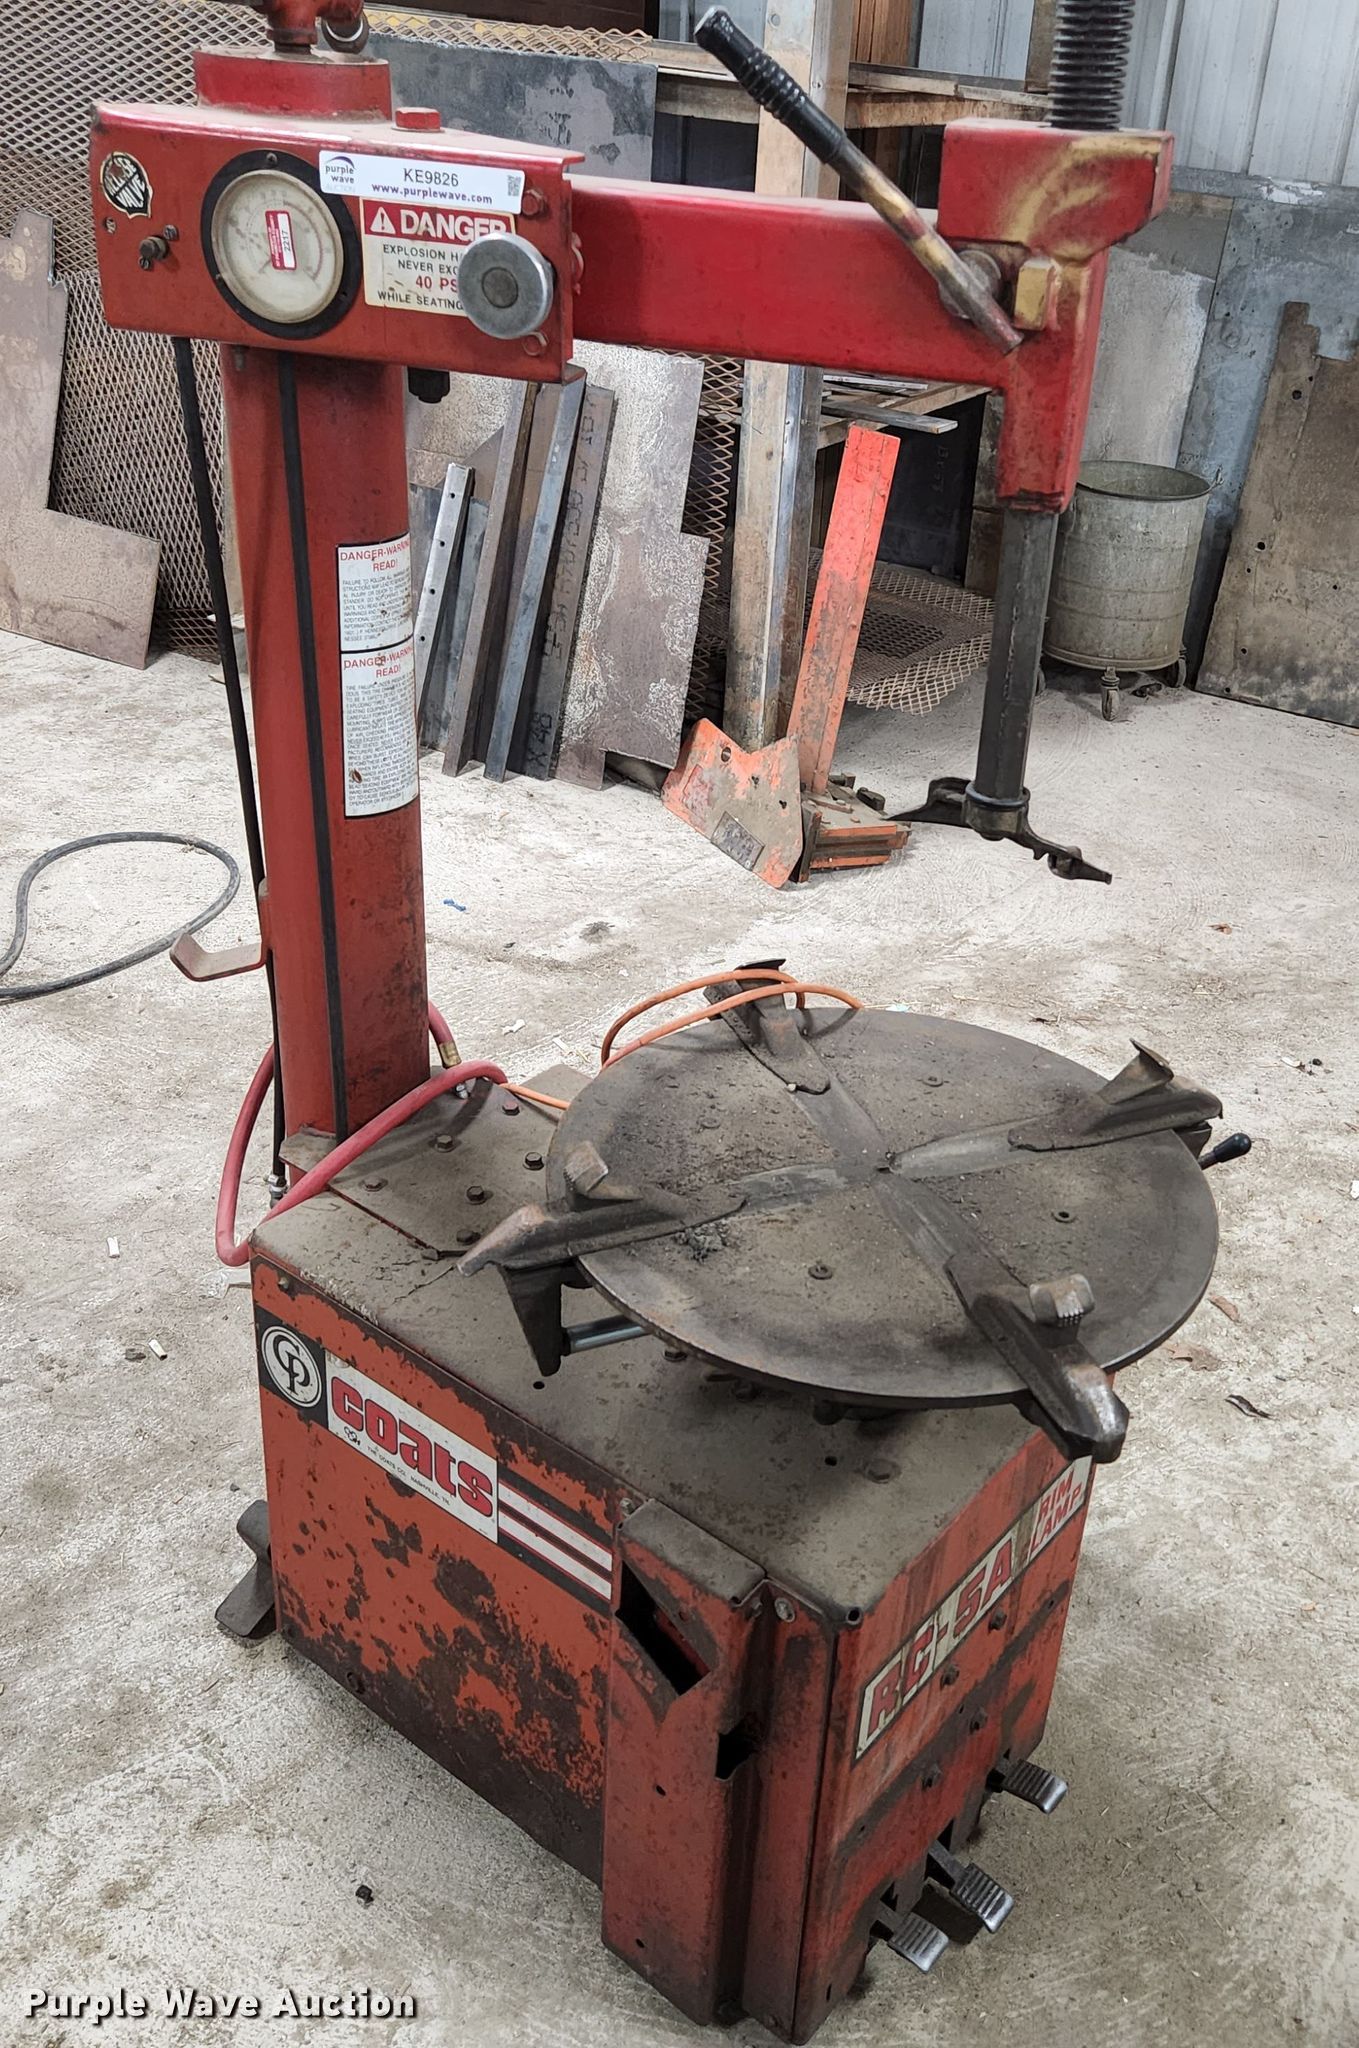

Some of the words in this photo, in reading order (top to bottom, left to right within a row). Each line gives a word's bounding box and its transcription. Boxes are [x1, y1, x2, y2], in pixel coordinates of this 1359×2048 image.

[325, 164, 354, 176] purple
[331, 174, 355, 184] wave
[403, 168, 459, 187] KE9826
[115, 174, 145, 207] VALVE
[371, 183, 493, 204] www.purplewave.com
[400, 209, 507, 242] DANGER
[383, 244, 446, 261] EXPLOSION
[398, 260, 434, 273] NEVER
[439, 265, 459, 275] EXC
[416, 276, 432, 289] 40
[440, 277, 459, 294] PS
[378, 290, 410, 304] WHILE
[416, 295, 464, 310] SEATING
[1040, 1467, 1075, 1521] RIM
